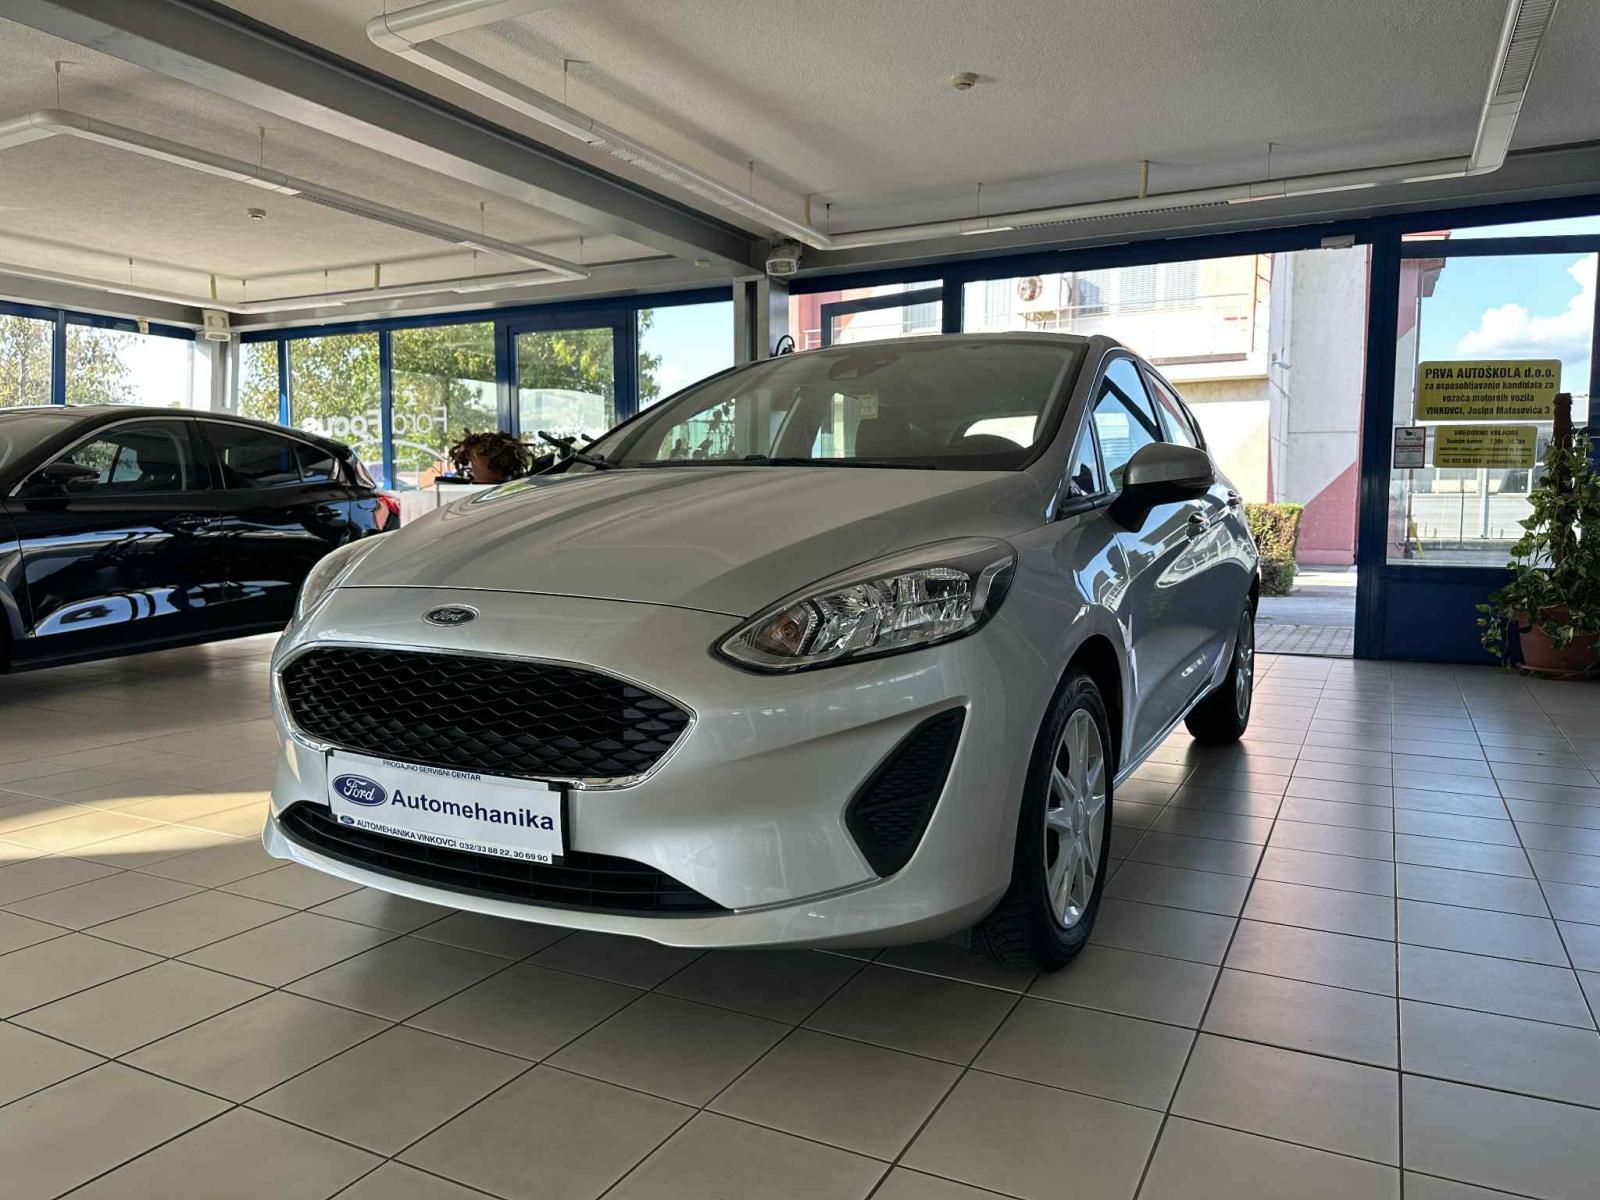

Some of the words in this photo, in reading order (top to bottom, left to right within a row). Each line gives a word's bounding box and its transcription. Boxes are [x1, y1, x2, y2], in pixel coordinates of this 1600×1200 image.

[1425, 368, 1453, 379] PRVA
[1457, 365, 1521, 379] AUTOŠKOLA
[1524, 367, 1555, 378] d.o.o.
[1425, 382, 1434, 390] za
[1502, 381, 1543, 389] kandidata
[1544, 381, 1554, 389] za
[1472, 393, 1508, 402] motornih
[1510, 393, 1534, 401] vozila
[1425, 406, 1465, 415] VINKOVCI,
[1467, 406, 1494, 415] Josipa
[1544, 406, 1550, 415] 3
[383, 760, 418, 772] PRODAJNO
[451, 771, 481, 781] CENTAR
[343, 778, 375, 801] Ford
[391, 789, 554, 831] Automehanika
[357, 819, 416, 840] AUTOMEHANIKA
[417, 833, 457, 847] VINKOVCI
[459, 842, 486, 852] 032/33
[488, 847, 498, 855] 88
[537, 854, 548, 862] 90
